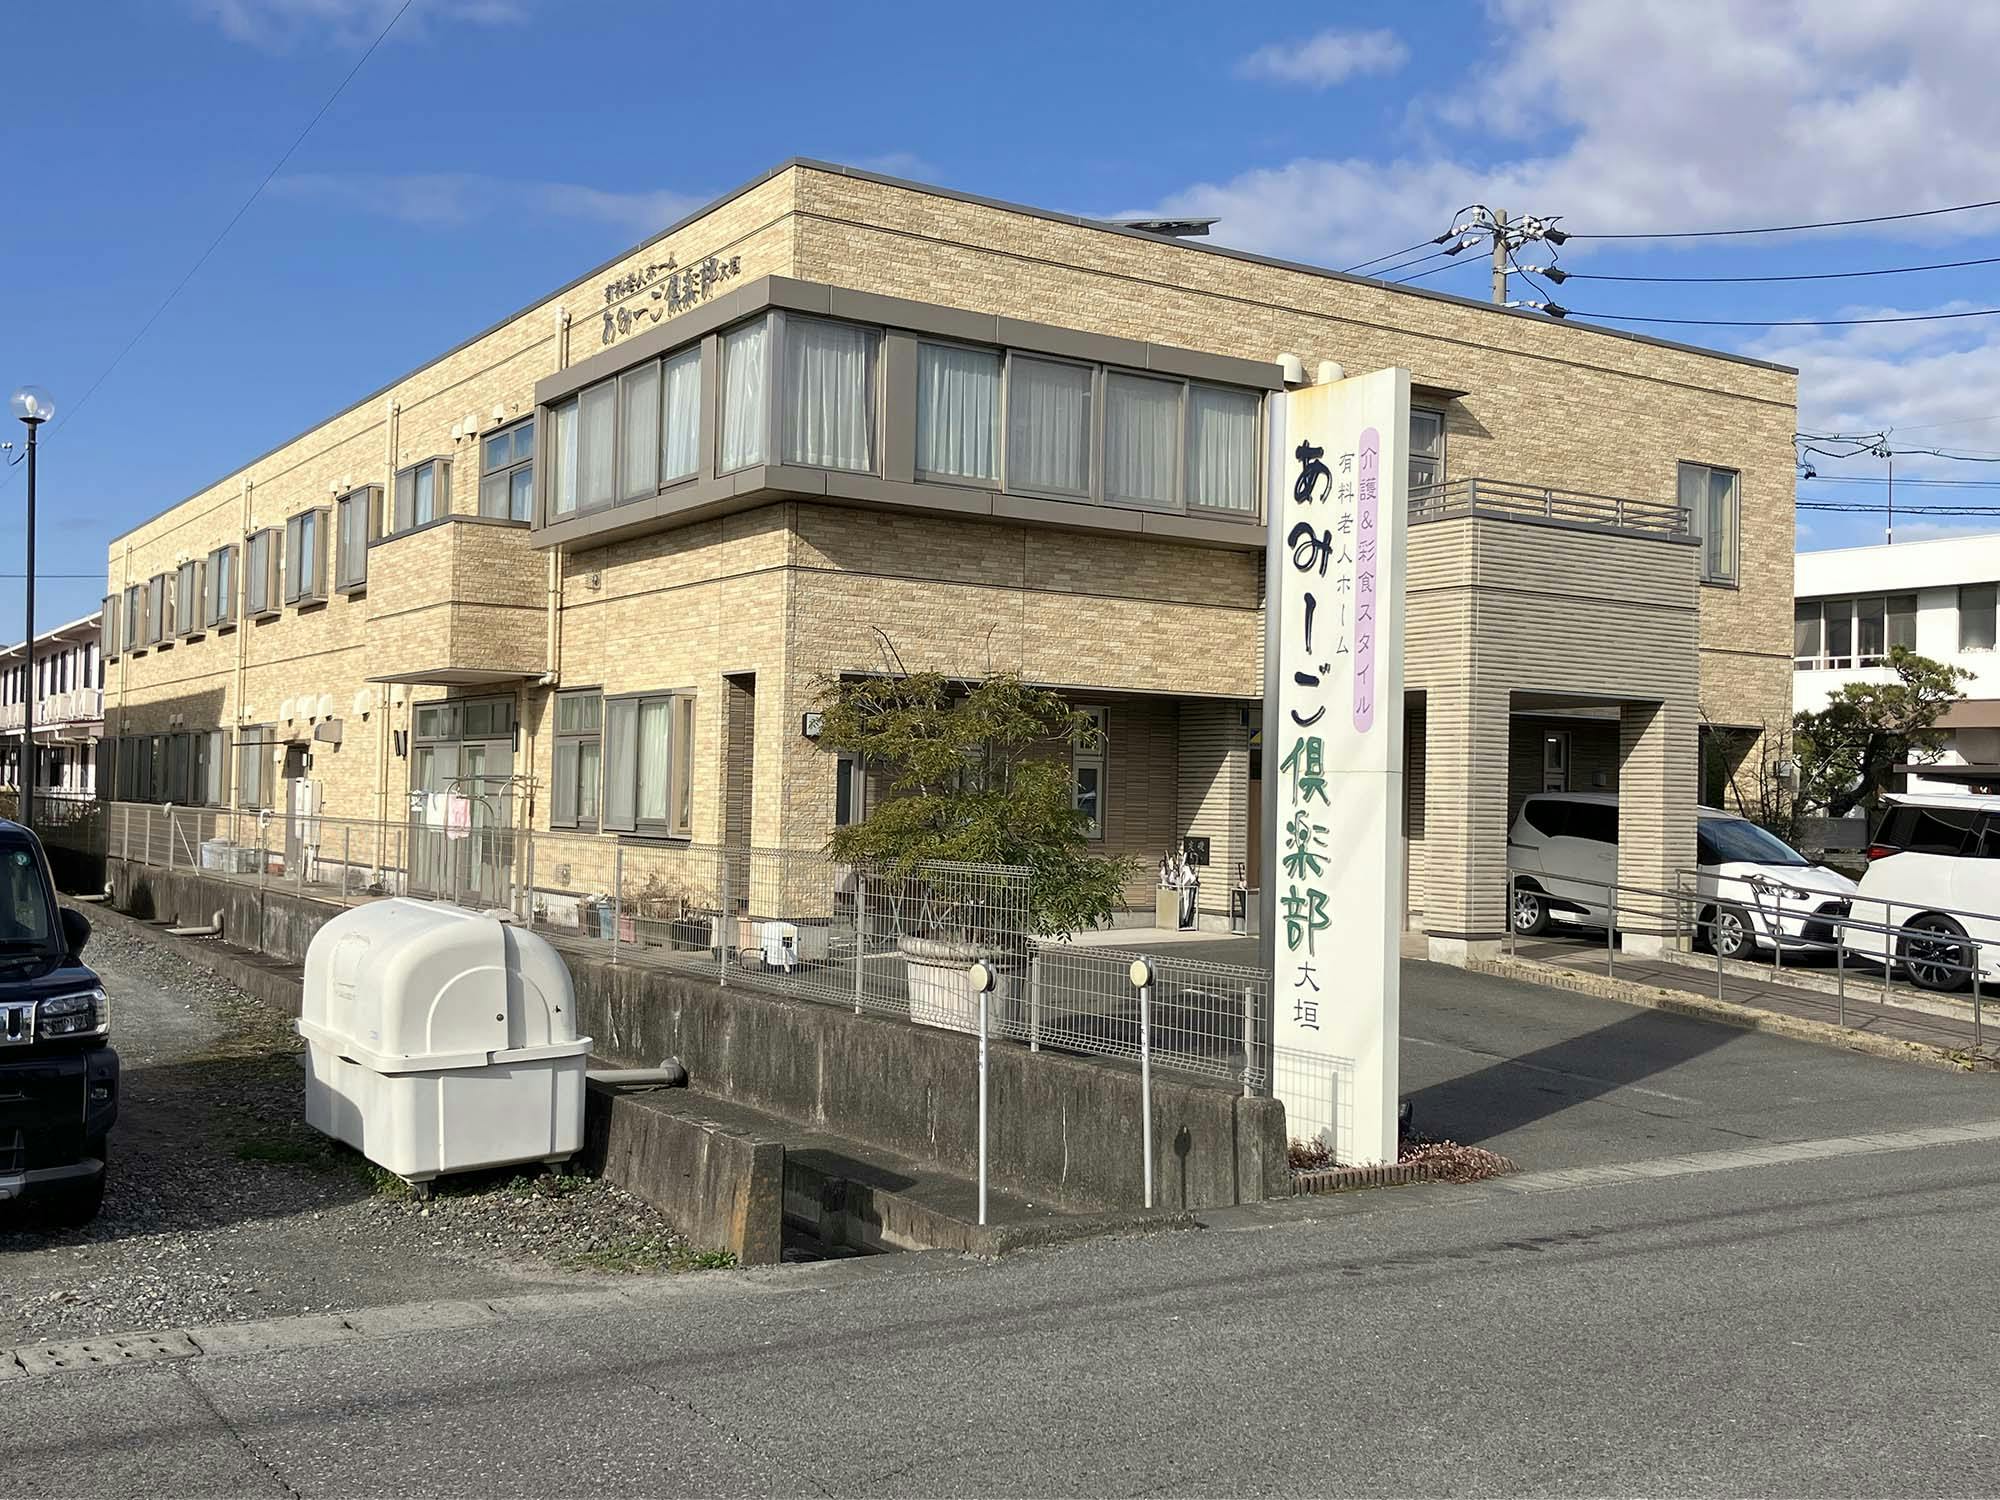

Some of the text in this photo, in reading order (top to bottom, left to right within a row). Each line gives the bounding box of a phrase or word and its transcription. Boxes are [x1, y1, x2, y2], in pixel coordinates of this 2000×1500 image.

[1336, 452, 1355, 655] 有料老人ホーム
[1356, 447, 1378, 715] 介護&彩食スタイル
